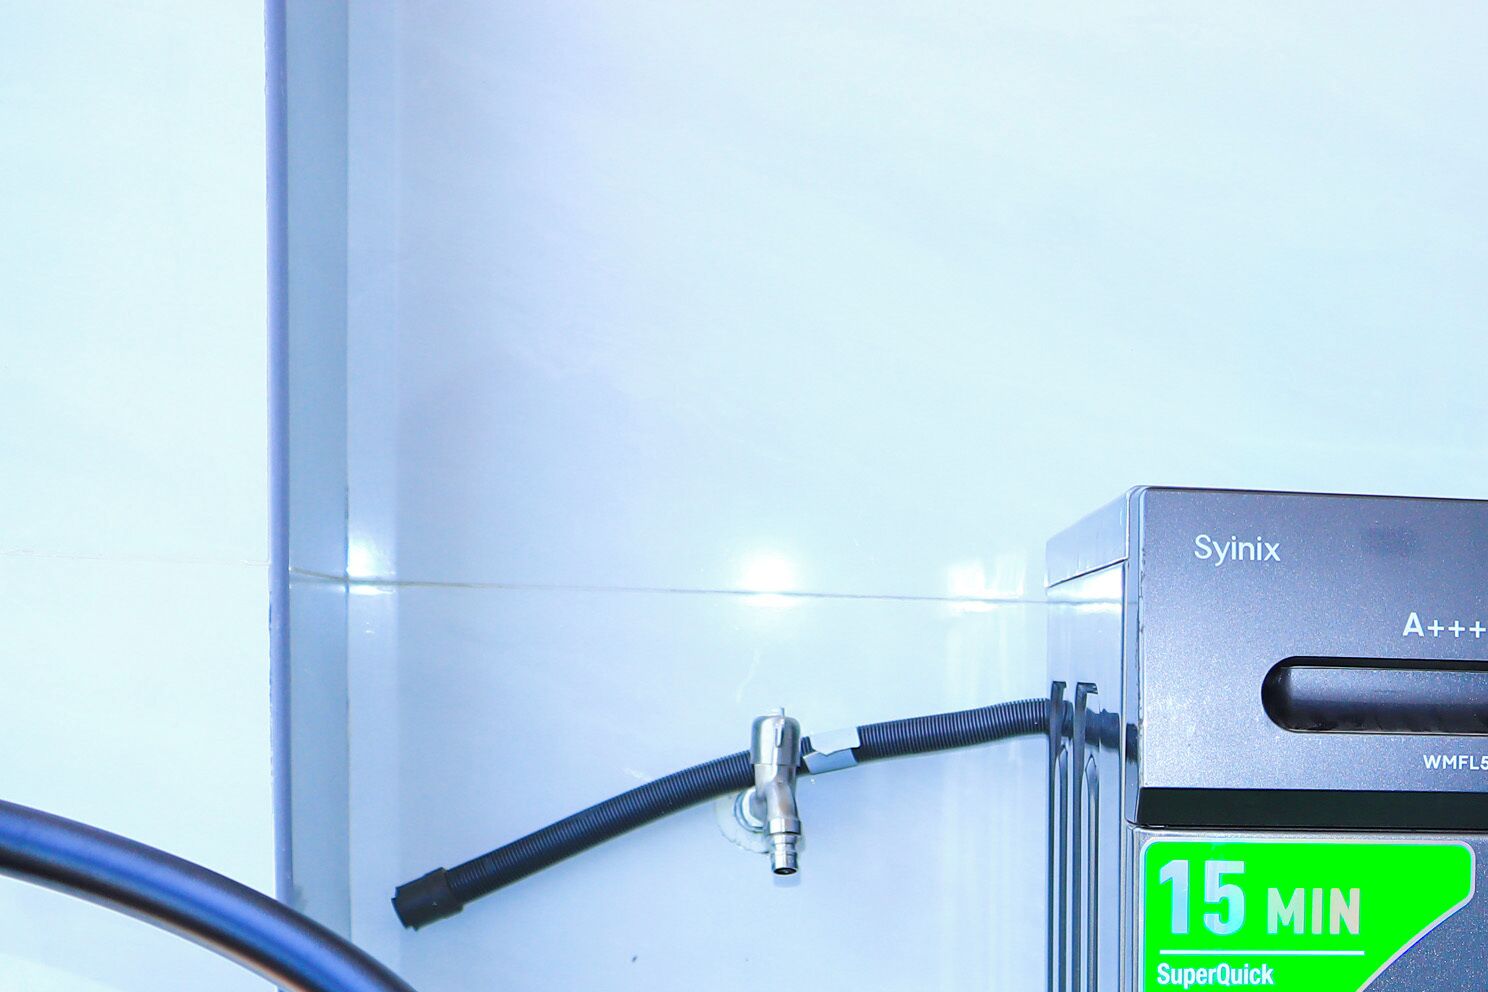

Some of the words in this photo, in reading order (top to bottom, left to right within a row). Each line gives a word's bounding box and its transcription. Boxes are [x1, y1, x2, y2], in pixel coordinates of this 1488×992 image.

[1193, 533, 1281, 567] Syinix
[1402, 611, 1487, 640] A+++
[1158, 859, 1246, 935] 15
[1267, 887, 1361, 935] MIN
[1157, 962, 1274, 989] SuperQuick
